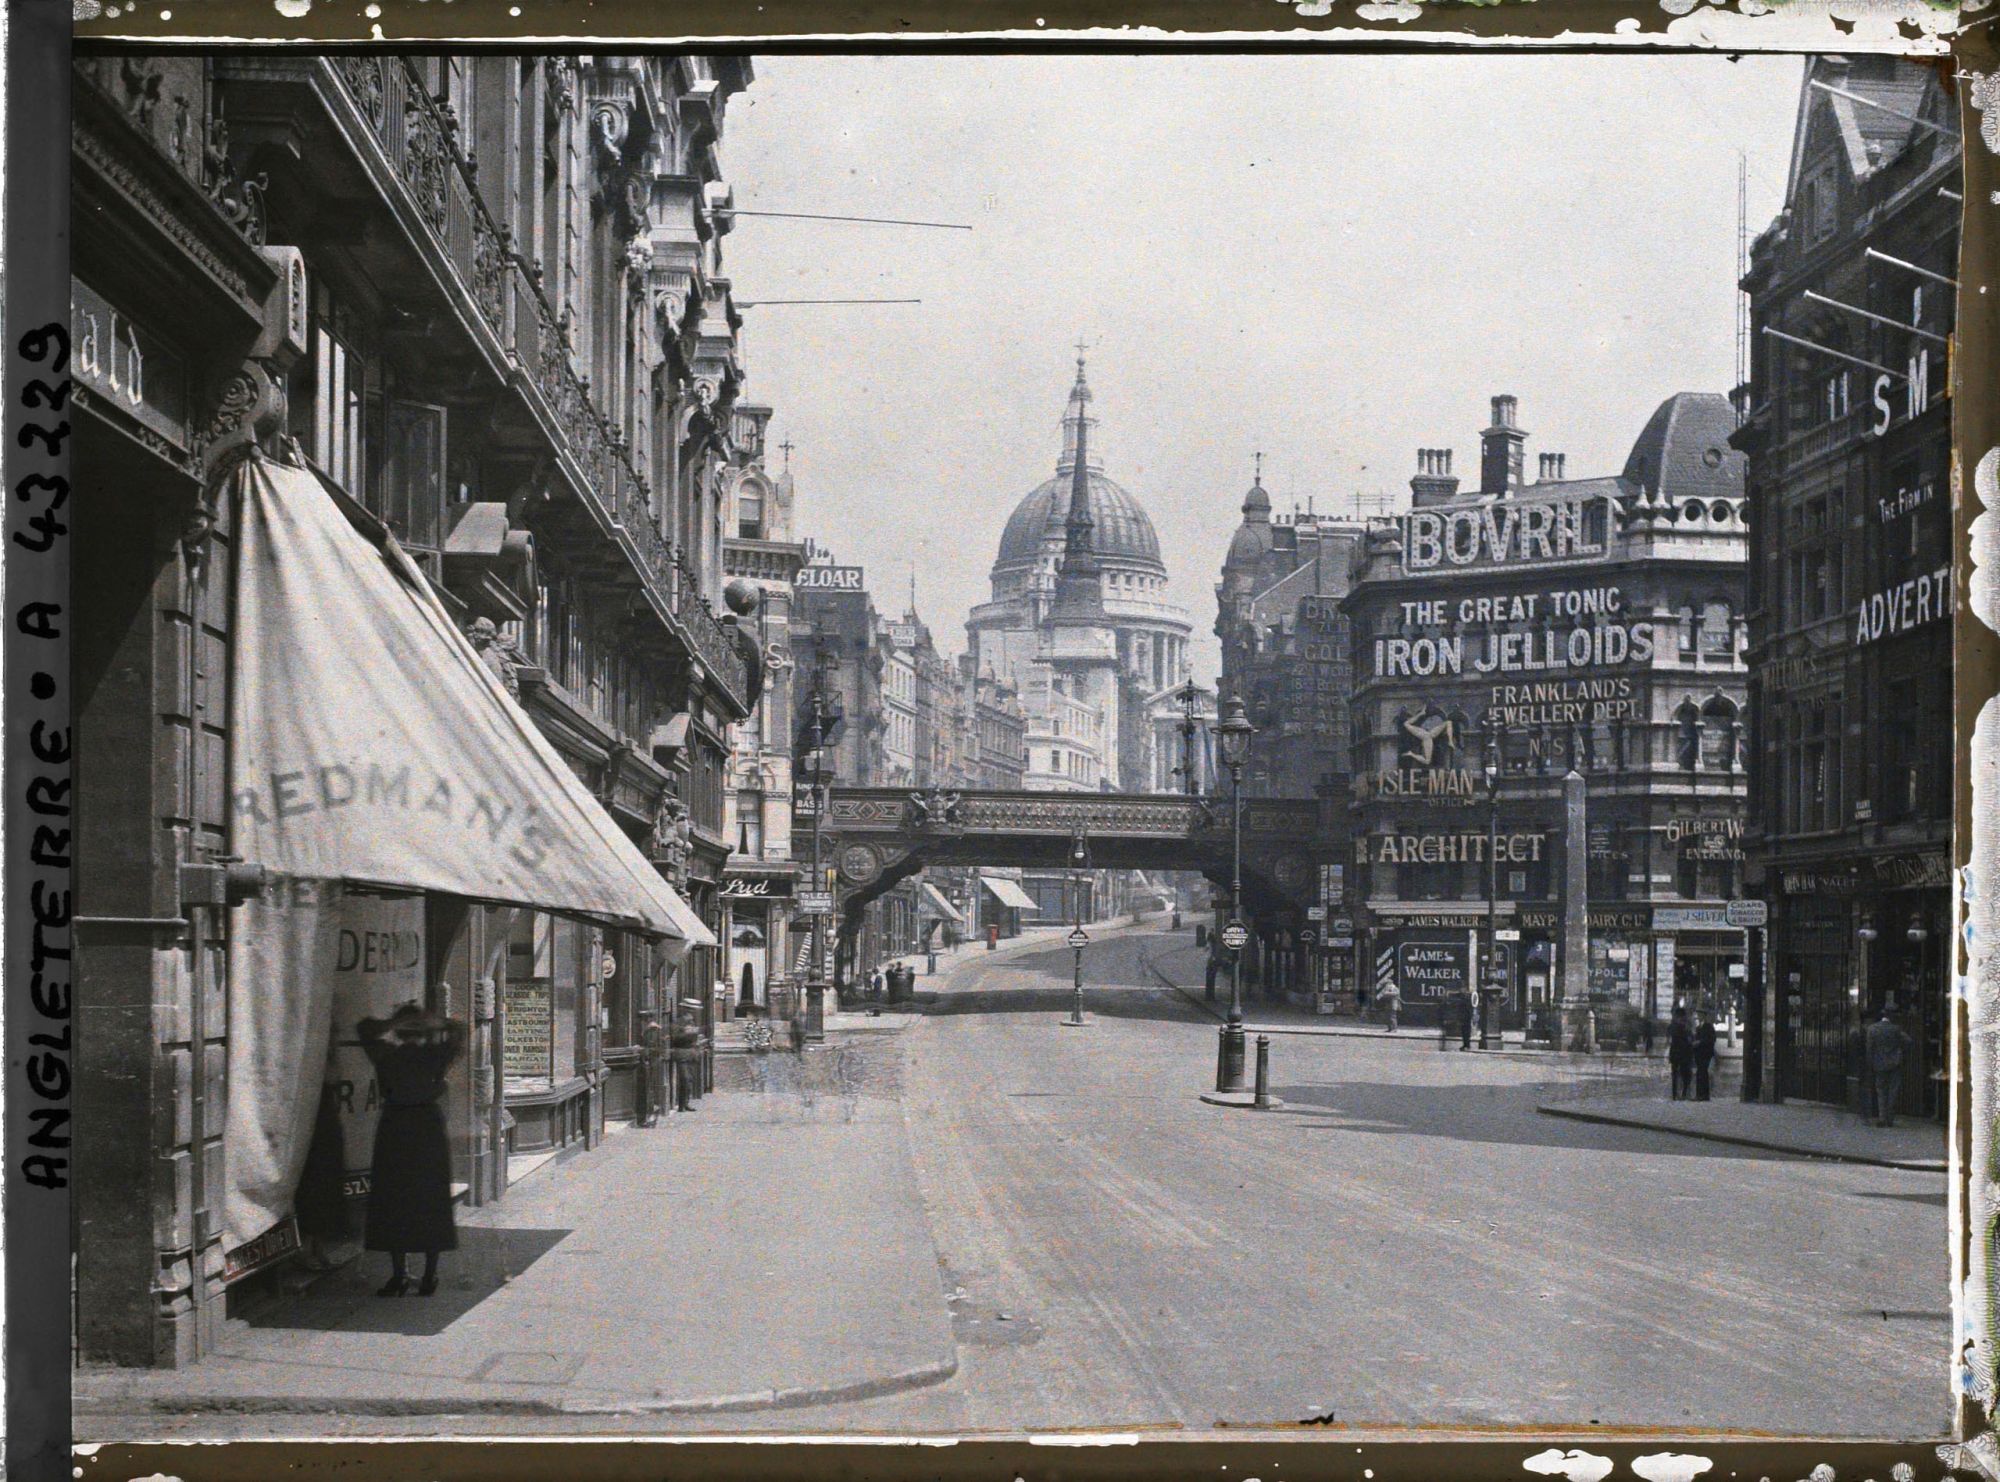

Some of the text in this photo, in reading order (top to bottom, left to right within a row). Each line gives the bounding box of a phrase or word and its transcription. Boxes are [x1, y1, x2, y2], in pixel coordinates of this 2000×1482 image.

[1411, 500, 1602, 568] BOVRIL
[1401, 586, 1620, 625] THE GREAT TONIC
[1375, 623, 1653, 676] IRON JELLOIDS
[1492, 678, 1630, 704] FRANKLAND'S
[1593, 699, 1643, 720] DEPT.
[1378, 769, 1473, 796] ISLE MAN
[1666, 819, 1724, 842] GILBERT
[1379, 834, 1545, 864] ARCHITECT
[1408, 916, 1439, 927] JAMES
[1441, 915, 1479, 927] WALKER
[1405, 965, 1461, 980] WALKER
